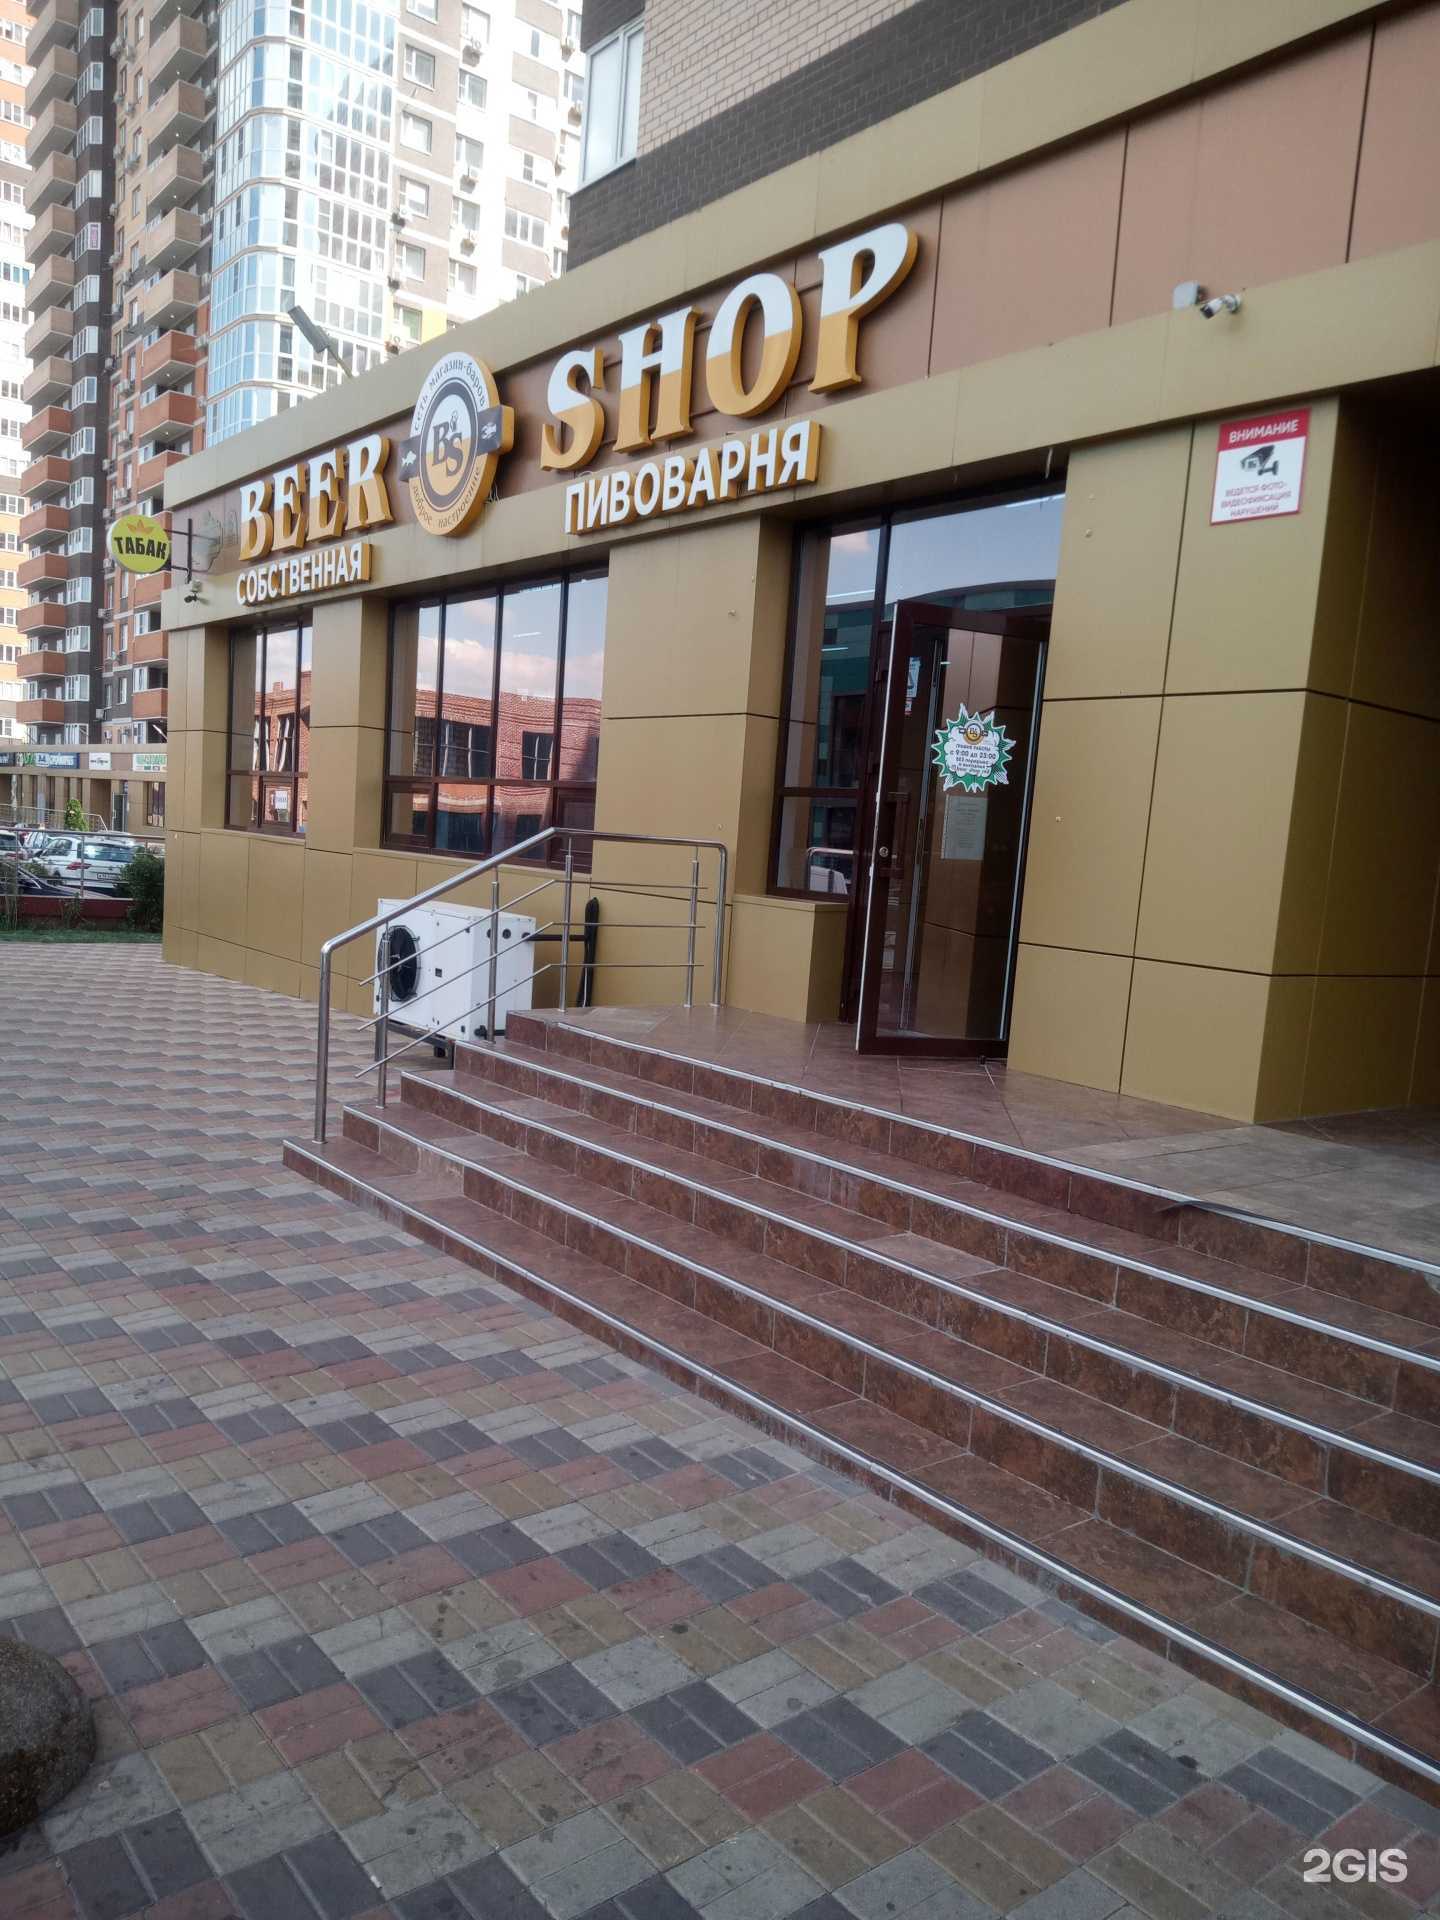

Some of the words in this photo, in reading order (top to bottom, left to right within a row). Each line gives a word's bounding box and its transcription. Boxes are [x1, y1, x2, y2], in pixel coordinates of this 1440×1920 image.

[540, 222, 917, 472] SHOP
[1229, 419, 1299, 443] ВНИМАНИЕ
[239, 433, 393, 561] BEER
[564, 420, 817, 535] ПИВОВАРНЯ
[114, 536, 167, 559] ТАБАК
[236, 541, 367, 606] СОБСТВЕННАЯ
